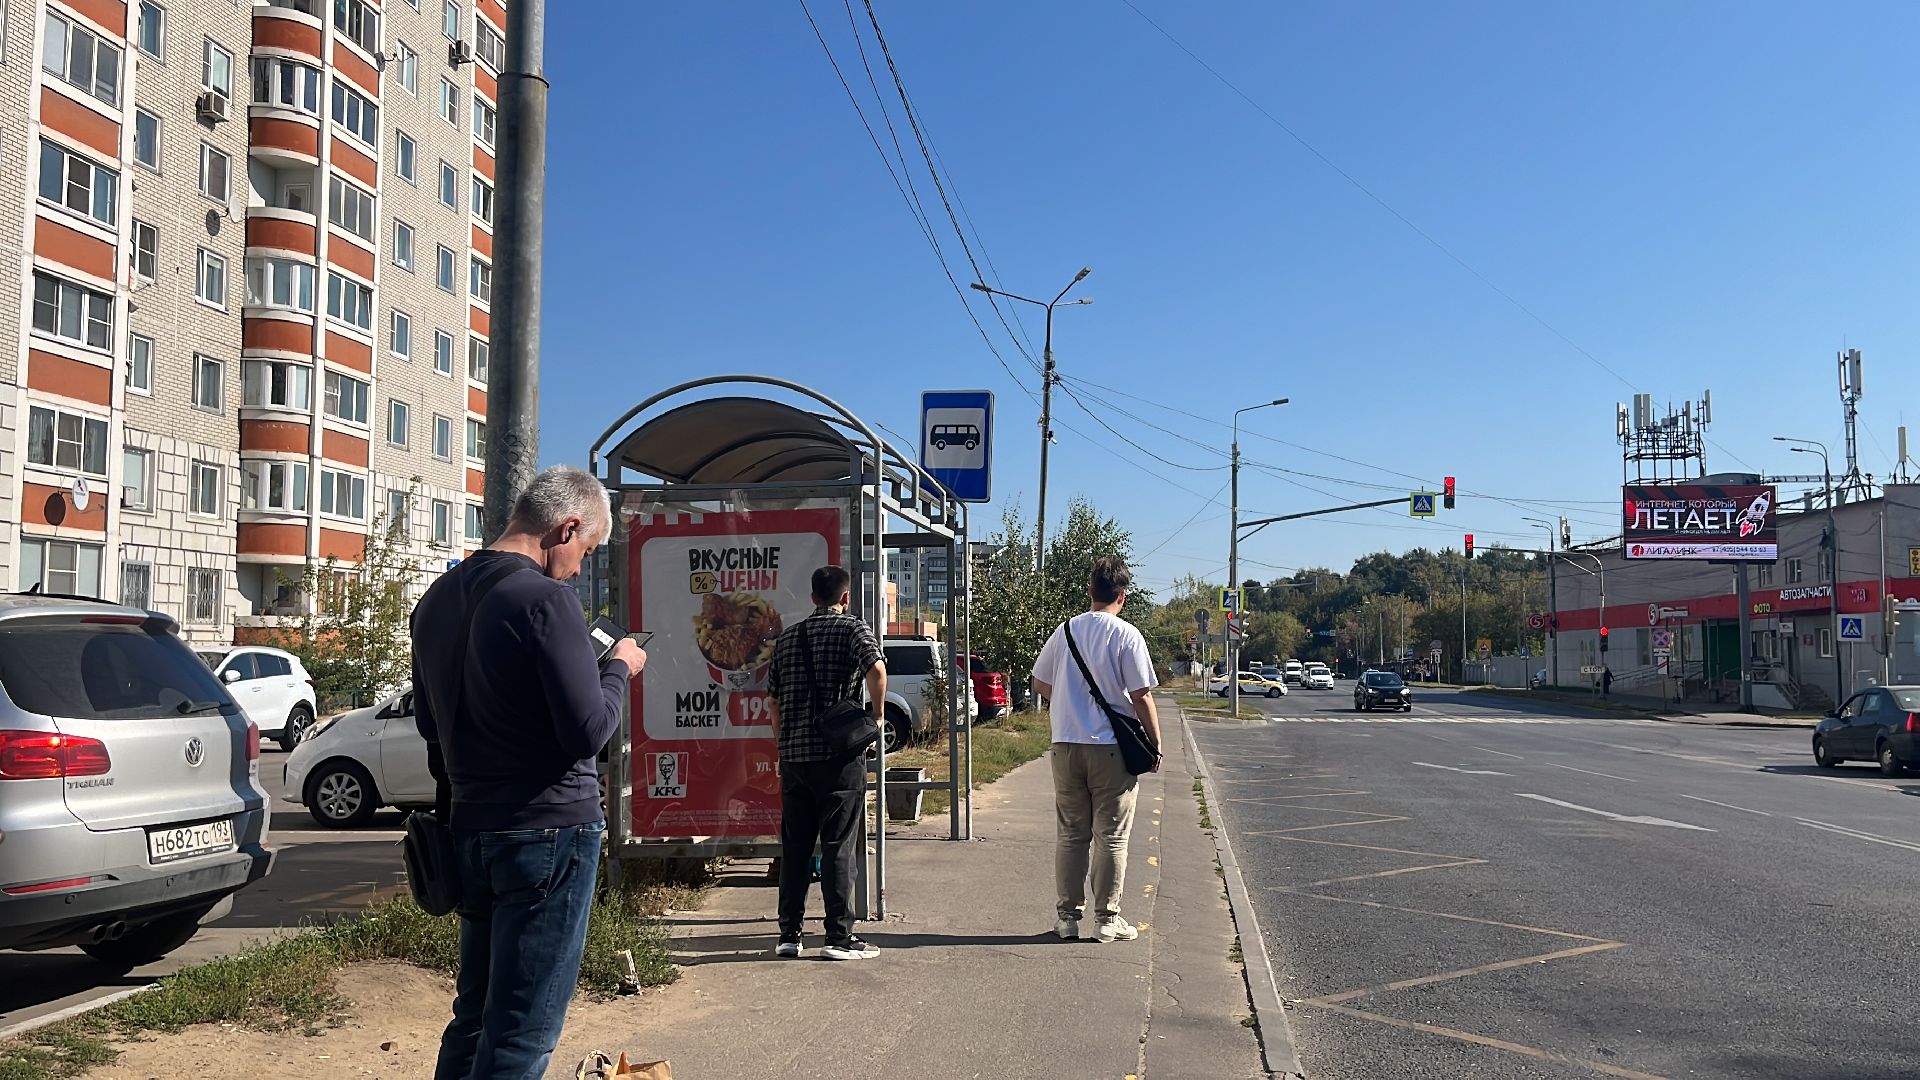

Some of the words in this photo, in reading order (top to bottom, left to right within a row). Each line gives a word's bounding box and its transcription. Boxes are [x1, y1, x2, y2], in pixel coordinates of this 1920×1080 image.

[1636, 500, 1687, 509] ИНТЕРНЕТ,
[1689, 500, 1737, 508] КОТОРЫЙ
[1631, 508, 1736, 530] ЛЕТАЕТ
[1646, 546, 1697, 556] ЛИГАЛИНК
[688, 547, 781, 572] ВКУСНЫЕ
[720, 569, 778, 593] ЦЕНЫ
[1780, 585, 1832, 601] АВТОЗАПЧАСТИ
[1753, 603, 1771, 614] ФОТО
[675, 683, 720, 713] МОЙ
[675, 714, 721, 728] БАСКЕТ
[67, 778, 114, 790] TIGUAN
[654, 786, 681, 796] KFC
